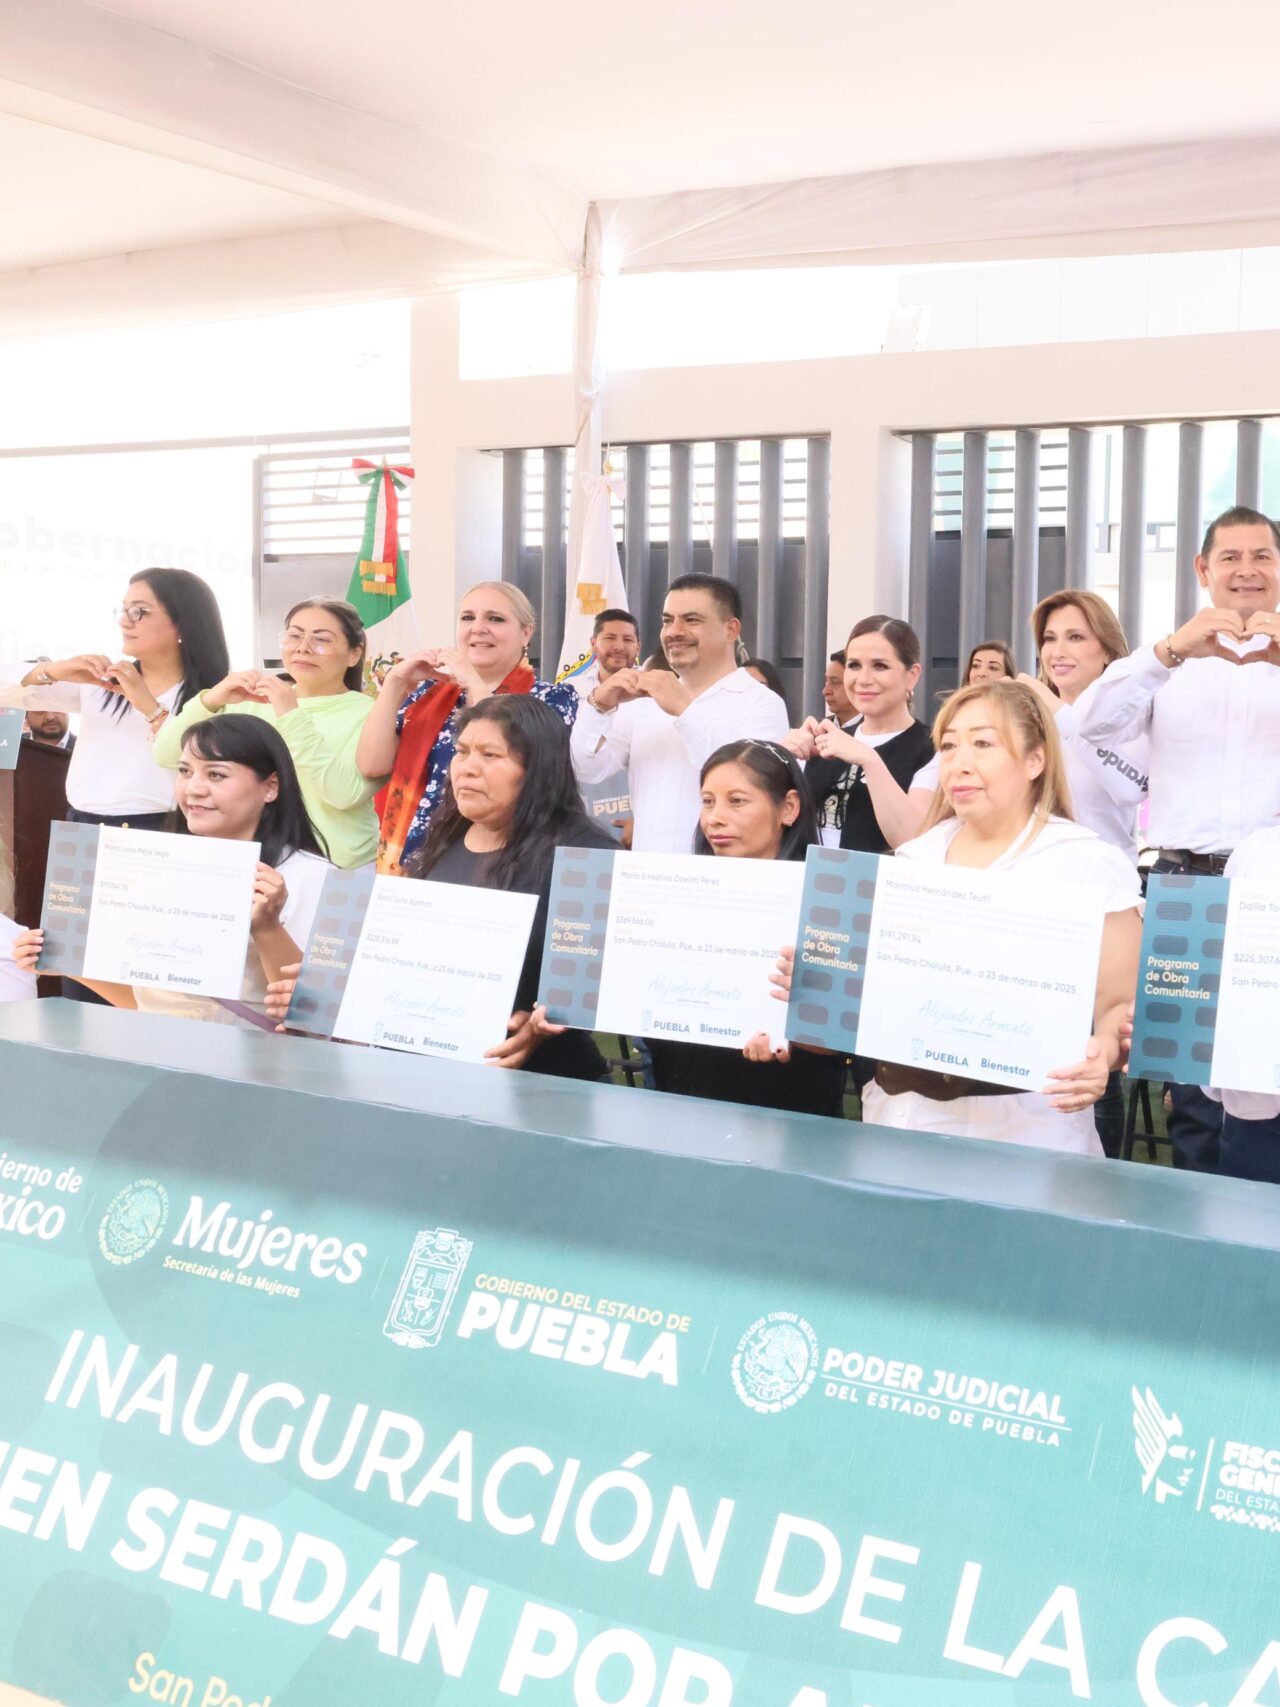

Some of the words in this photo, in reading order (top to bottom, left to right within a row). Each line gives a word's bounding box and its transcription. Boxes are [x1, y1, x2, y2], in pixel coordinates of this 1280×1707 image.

[50, 882, 80, 893] Programa
[48, 892, 57, 900] de
[58, 894, 74, 903] Obra
[47, 902, 86, 915] Comunitaria
[1239, 901, 1266, 912] Dalila
[553, 919, 591, 931] Programa
[314, 933, 344, 946] Programa
[552, 931, 561, 940] de
[563, 932, 583, 942] Obra
[805, 926, 850, 943] Programa
[310, 945, 319, 953] de
[320, 946, 336, 956] Obra
[550, 943, 598, 956] Comunitaria
[803, 940, 815, 950] de
[817, 941, 841, 954] Obra
[308, 956, 347, 970] Comunitaria
[801, 952, 858, 971] Comunitaria
[1147, 956, 1199, 970] Programa
[129, 970, 160, 981] PUEBLA
[168, 973, 201, 985] Bienestar
[1146, 970, 1160, 981] de
[1162, 972, 1189, 983] Obra
[1231, 977, 1249, 986] San
[1252, 978, 1279, 990] Pedro
[1145, 984, 1210, 999] Comunitaria
[654, 1021, 690, 1033] PUEBLA
[700, 1023, 741, 1037] Bienestar
[383, 1032, 414, 1046] PUEBLA
[423, 1037, 459, 1051] Bienestar
[925, 1049, 969, 1067] PUEBLA
[981, 1058, 1031, 1077] Bienestar
[55, 1167, 83, 1193] de
[172, 1196, 368, 1284] Mujeres
[162, 1255, 218, 1280] Secretaría
[220, 1269, 234, 1282] de
[236, 1272, 252, 1288] las
[253, 1277, 301, 1299] Mujeres
[475, 1273, 558, 1304] GOBIERNO
[561, 1292, 592, 1313] DEL
[596, 1299, 663, 1325] ESTADO
[666, 1314, 692, 1332] DE
[457, 1290, 679, 1386] PUEBLA
[822, 1347, 925, 1392] PODER
[928, 1370, 1066, 1424] JUDICIAL
[824, 1382, 858, 1403] DEL
[867, 1392, 941, 1420] ESTADO
[949, 1410, 975, 1428] DE
[982, 1418, 1060, 1447] PUEBLA
[1215, 1488, 1242, 1505] DEL
[44, 1328, 736, 1592] INAUGURACIÓN
[754, 1511, 921, 1645] DE
[942, 1559, 1092, 1700] LA
[0, 1440, 112, 1552] EN
[110, 1485, 489, 1679] SERDÁN
[128, 1652, 194, 1707] San
